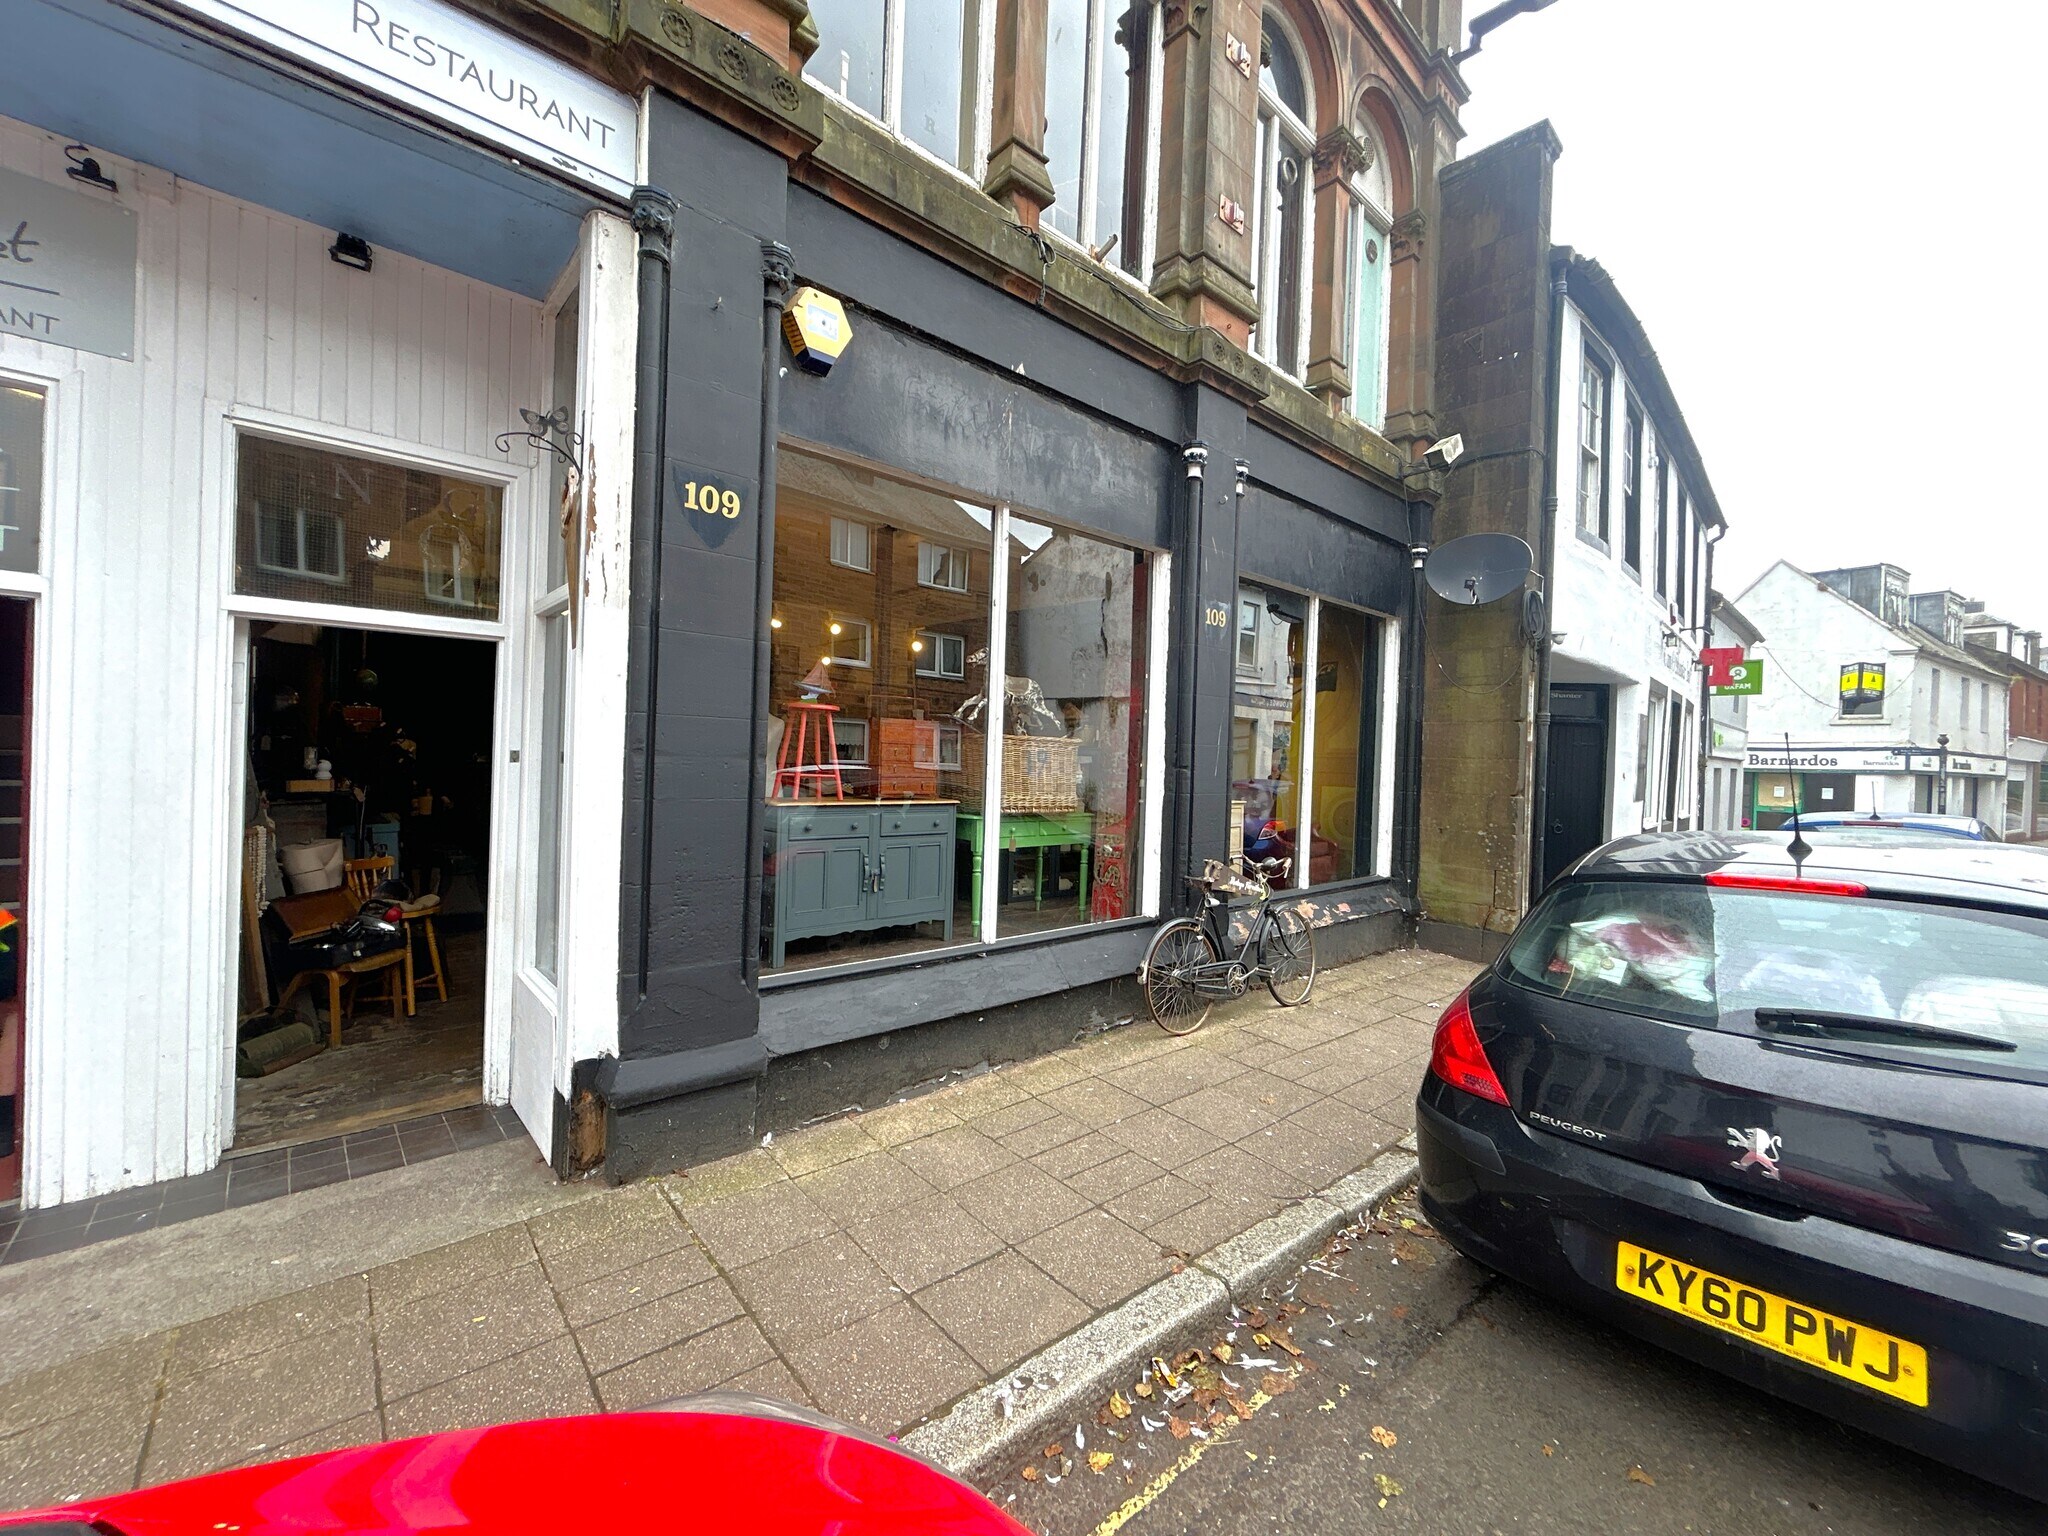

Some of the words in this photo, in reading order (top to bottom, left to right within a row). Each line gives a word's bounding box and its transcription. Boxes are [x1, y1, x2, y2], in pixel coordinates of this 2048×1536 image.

[684, 481, 741, 519] 109
[1205, 608, 1227, 628] 109
[1748, 754, 1838, 766] Barnardos
[1529, 1111, 1607, 1141] PEUGEOT
[1638, 1252, 1766, 1333] KY60
[1785, 1304, 1899, 1383] PWJ
